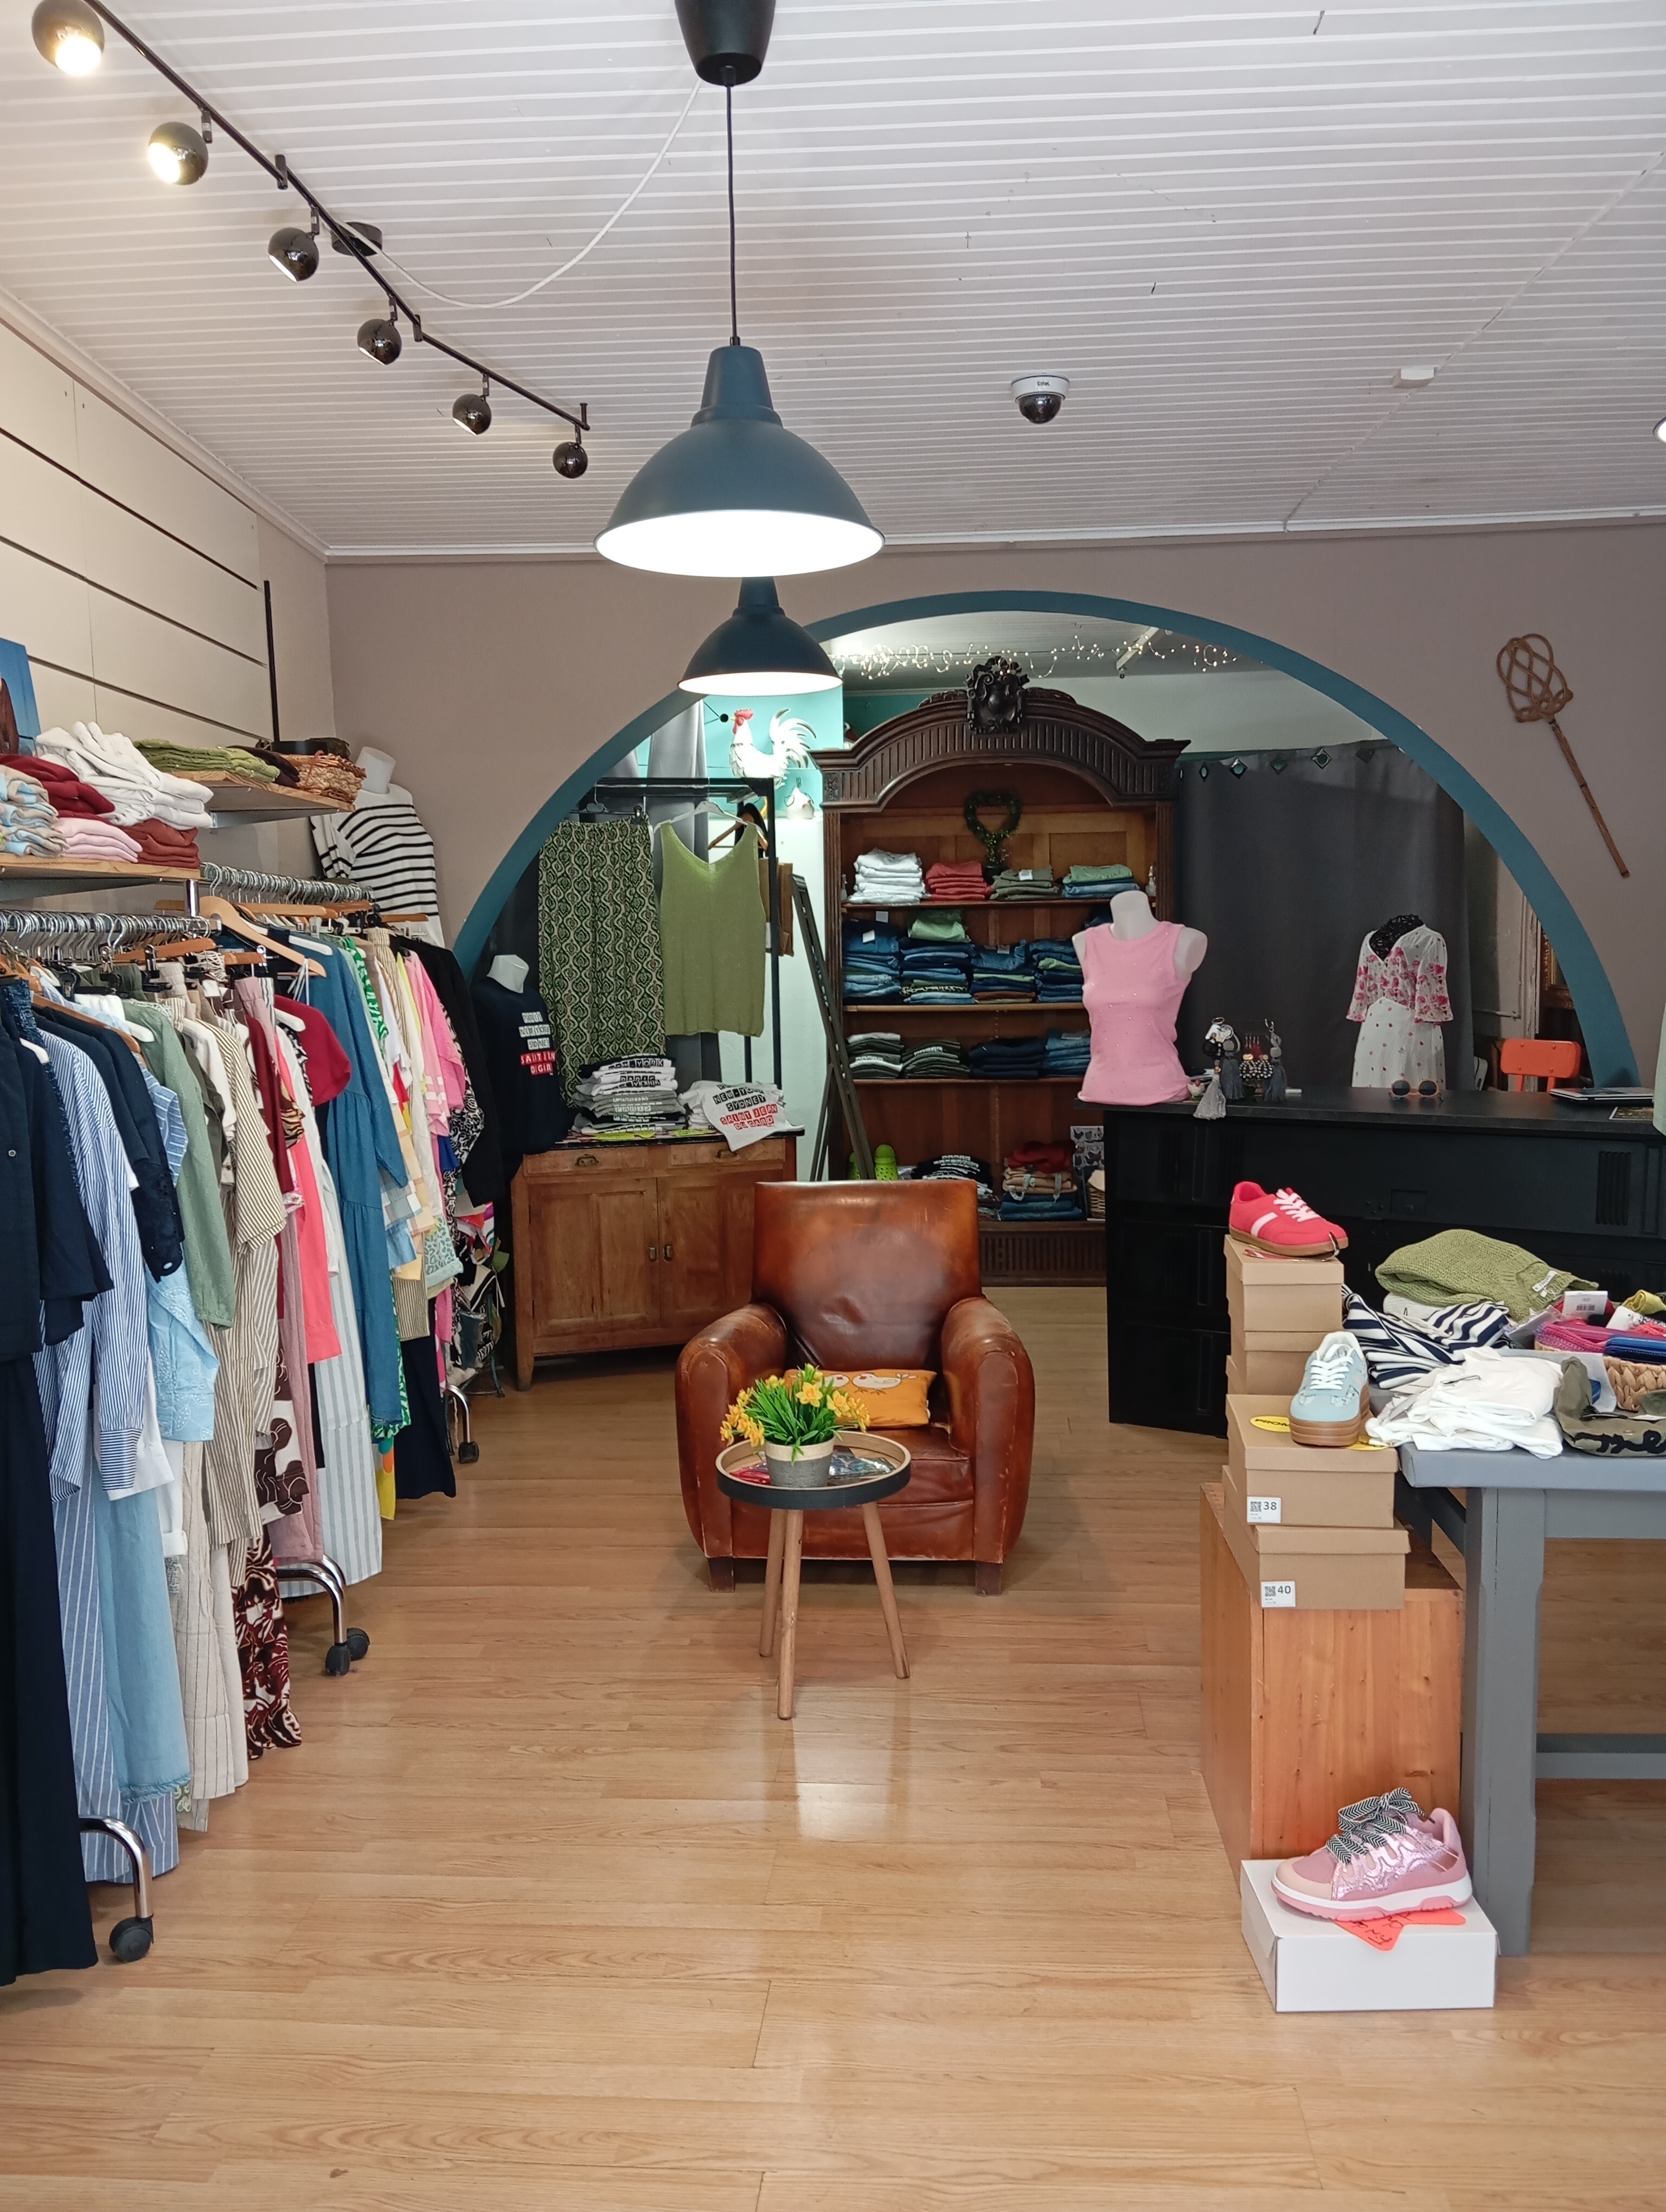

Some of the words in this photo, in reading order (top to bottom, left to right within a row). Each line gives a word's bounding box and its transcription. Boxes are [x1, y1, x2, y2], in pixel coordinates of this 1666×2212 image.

[726, 1094, 766, 1112] SYDNEY
[720, 1110, 752, 1125] SAINT
[752, 1103, 778, 1118] JEAN
[1263, 1501, 1277, 1510] 38
[1277, 1585, 1291, 1594] 40
